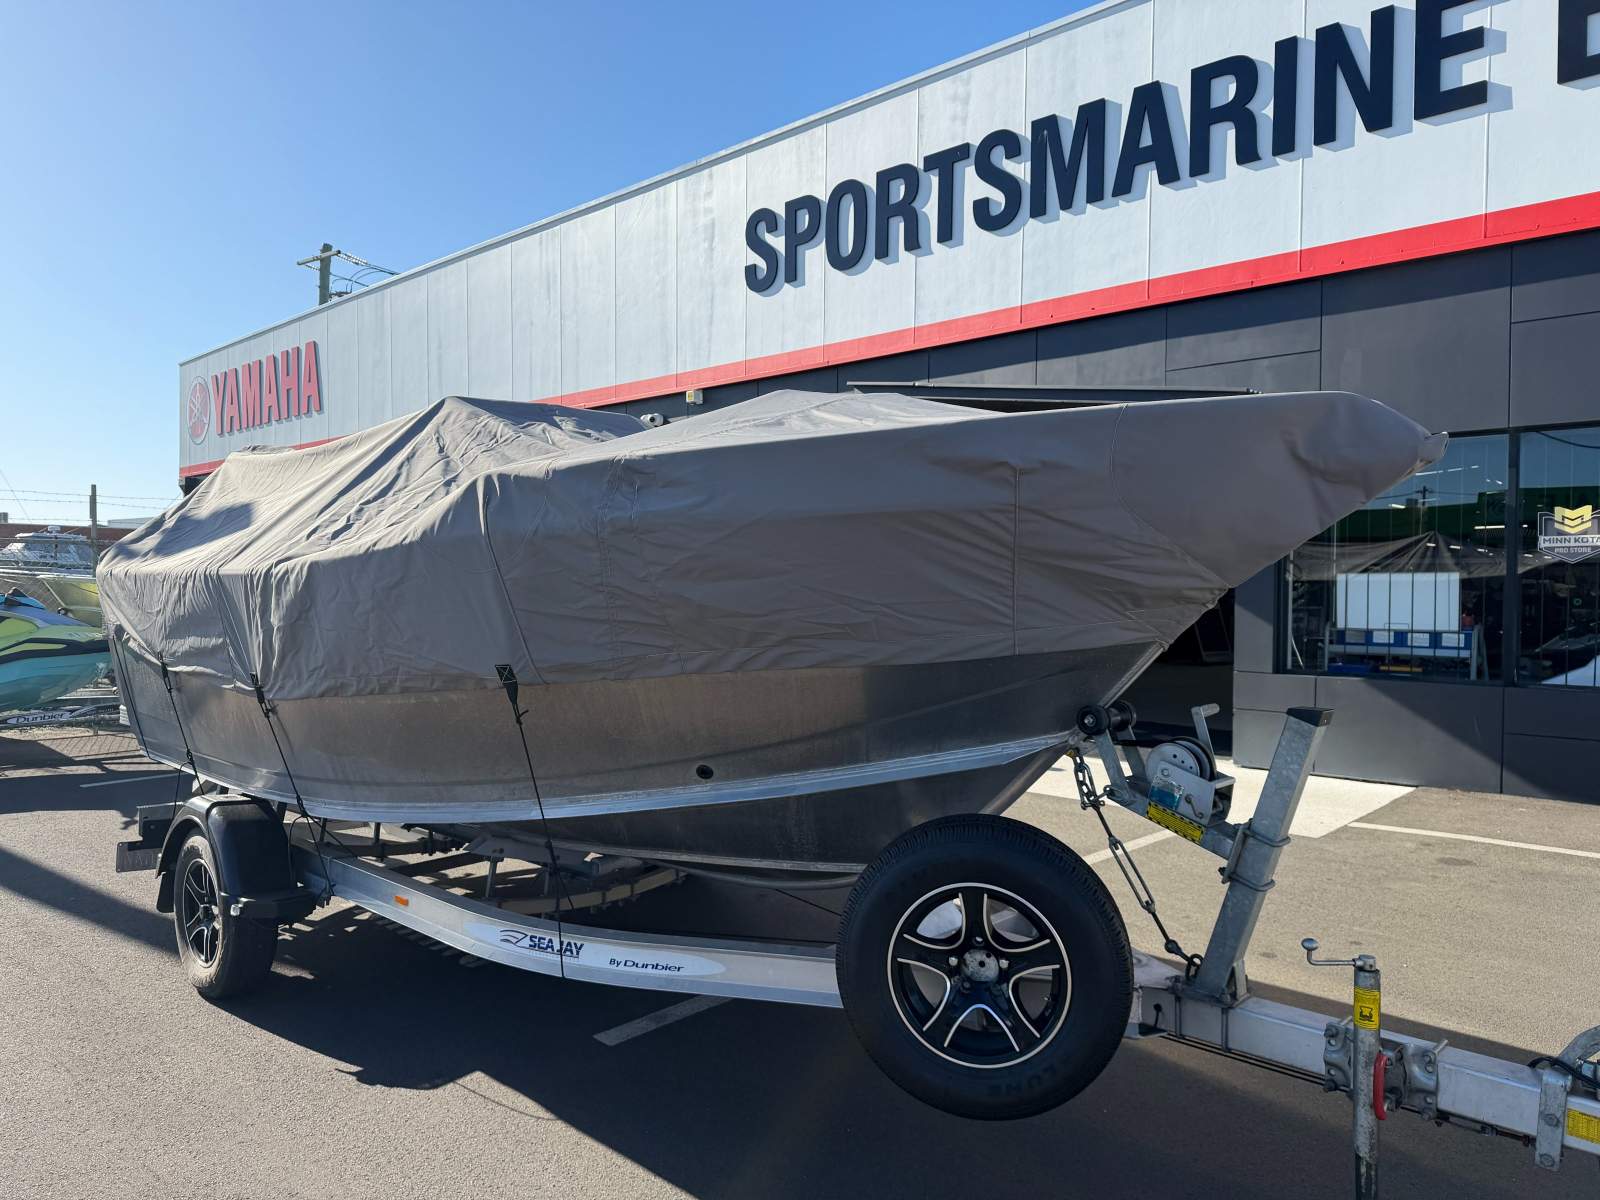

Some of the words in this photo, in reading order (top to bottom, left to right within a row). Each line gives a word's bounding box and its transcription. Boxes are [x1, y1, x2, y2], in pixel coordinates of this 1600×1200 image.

[744, 0, 1489, 292] SPORTSMARINE
[211, 341, 322, 436] YAMAHA
[1543, 536, 1571, 544] MINN
[16, 713, 64, 723] Dunbier
[528, 934, 555, 952] SEA
[609, 958, 622, 968] By
[623, 959, 685, 972] Dunbier
